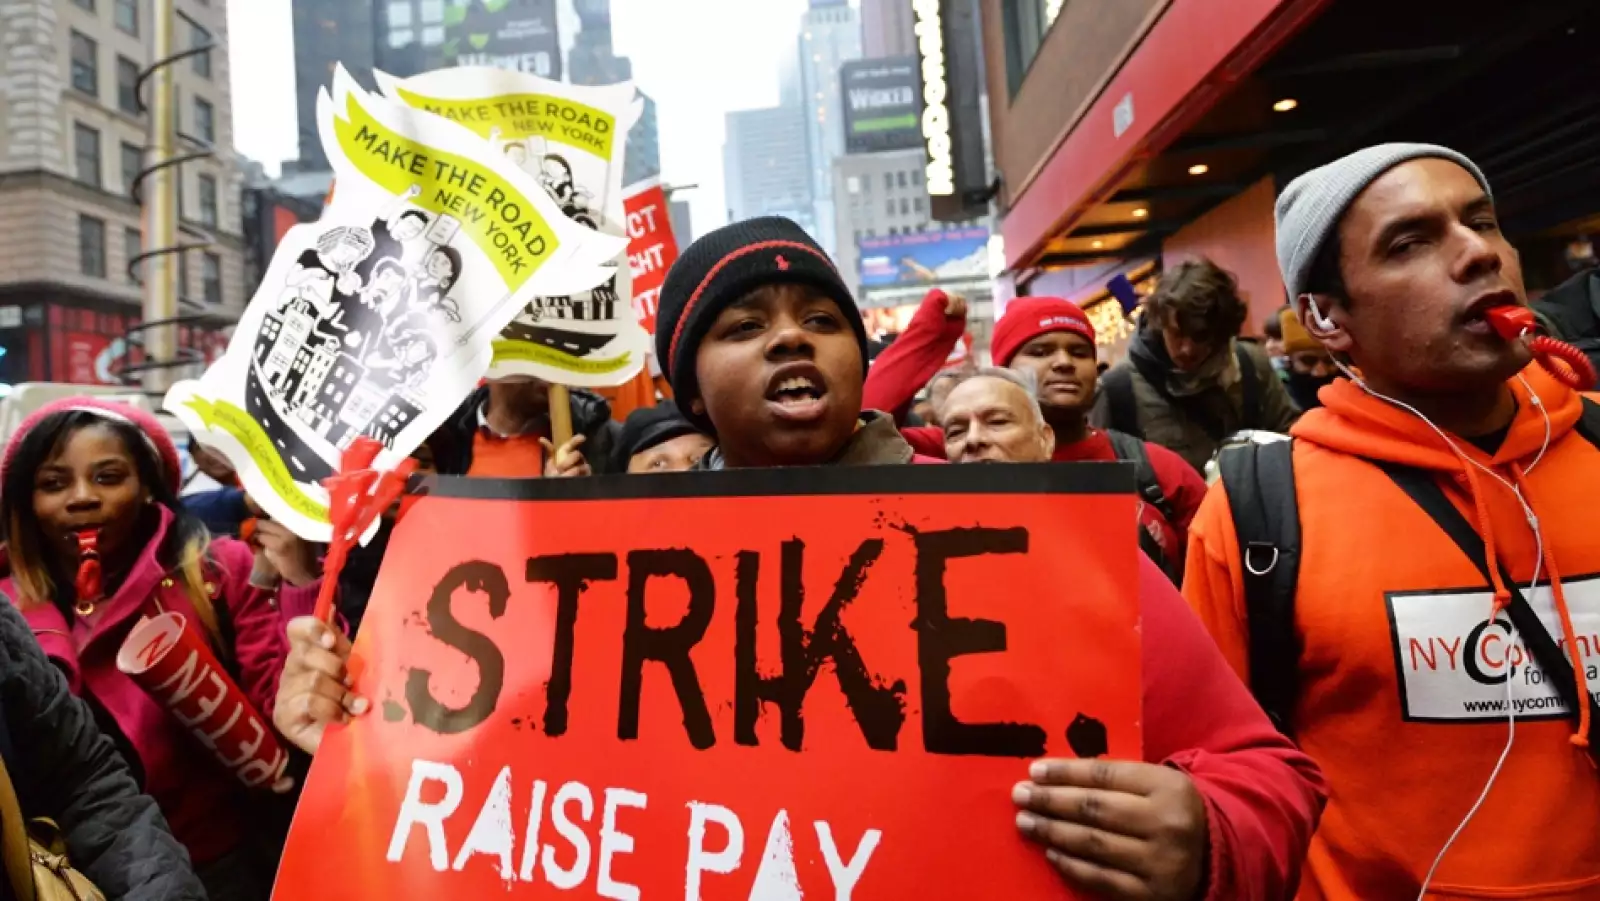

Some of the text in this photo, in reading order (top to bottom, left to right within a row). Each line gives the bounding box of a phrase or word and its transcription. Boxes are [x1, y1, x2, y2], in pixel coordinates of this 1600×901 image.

[493, 100, 540, 118] THE
[545, 102, 609, 133] ROAD
[512, 119, 606, 150] NEW YORK
[354, 124, 546, 257] MAKE THE ROAD
[434, 189, 528, 275] NEW YORK
[404, 522, 1108, 758] STRIKE.
[386, 758, 648, 901] RAISE
[686, 800, 882, 901] PAY
